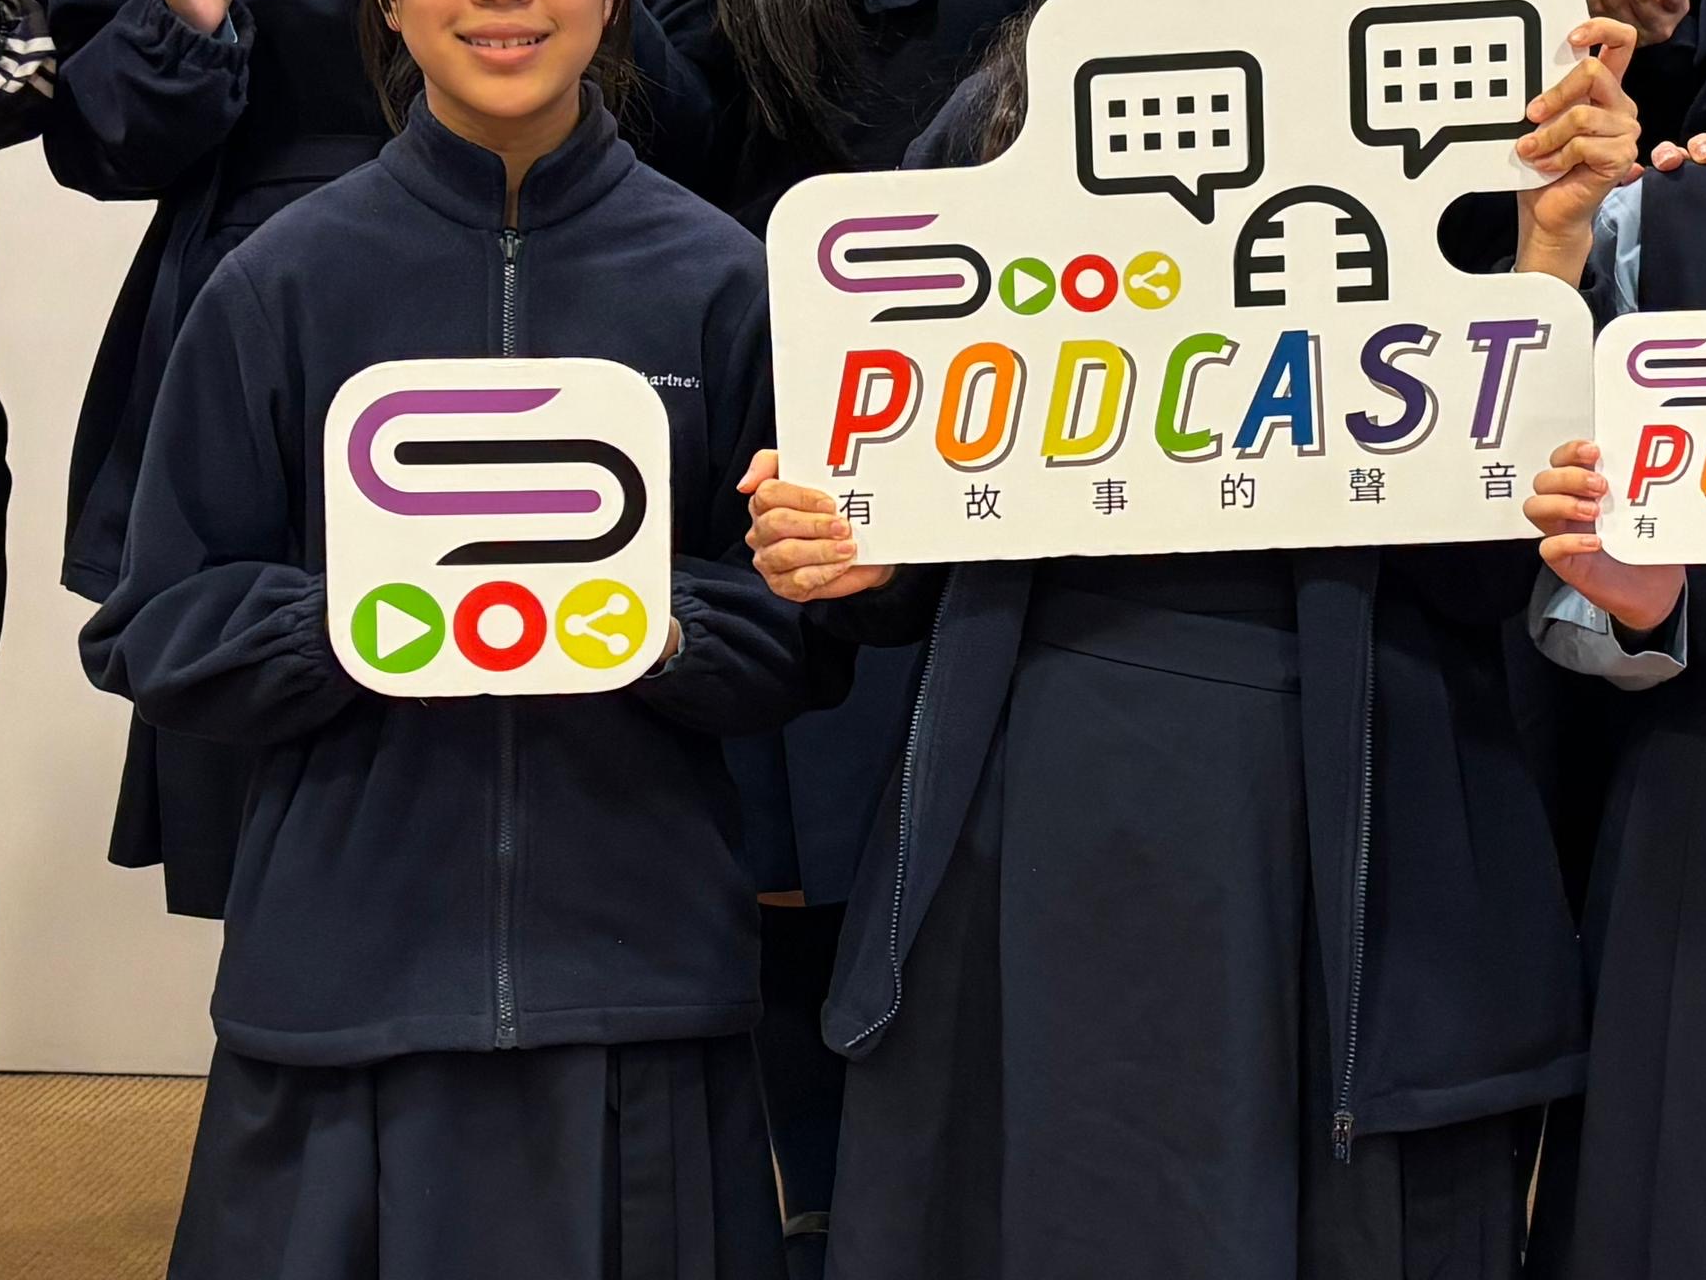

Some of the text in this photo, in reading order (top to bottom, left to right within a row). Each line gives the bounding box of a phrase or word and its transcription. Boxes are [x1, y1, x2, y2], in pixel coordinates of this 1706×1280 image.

[826, 320, 1551, 477] PODCAST
[837, 461, 1518, 525] 有故事的聲音
